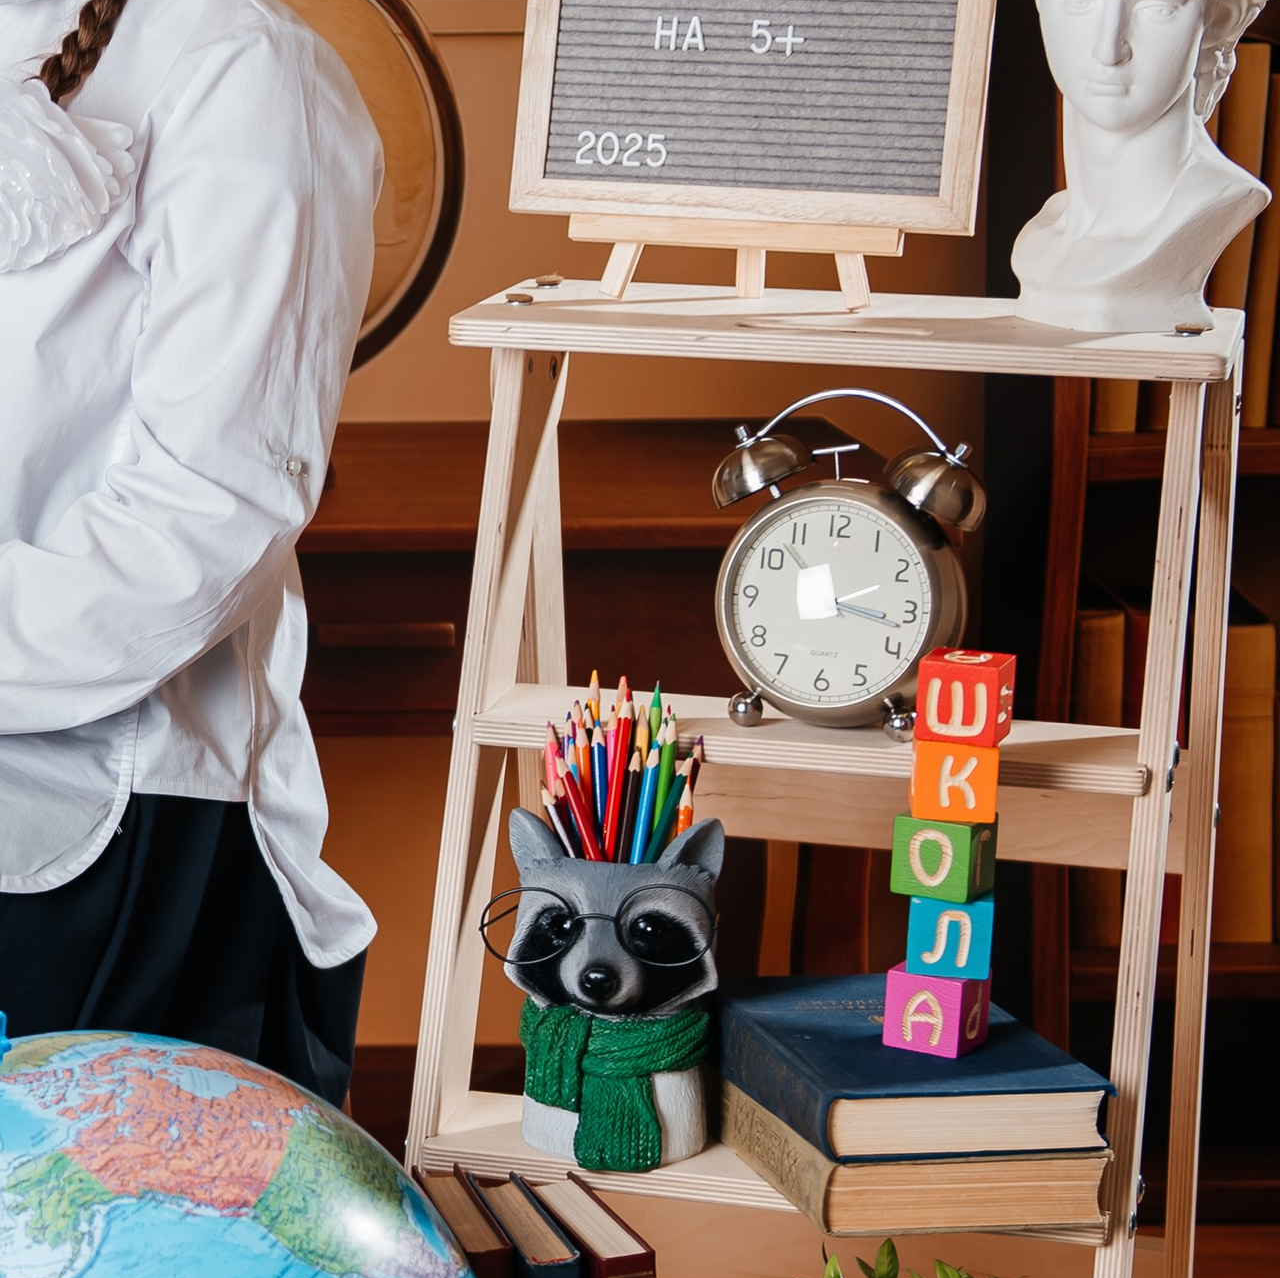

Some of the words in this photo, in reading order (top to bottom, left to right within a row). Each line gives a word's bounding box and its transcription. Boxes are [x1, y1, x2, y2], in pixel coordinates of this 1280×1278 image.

[654, 16, 705, 52] НА
[750, 19, 806, 57] 5+
[574, 130, 668, 168] 2025
[791, 522, 807, 545] 11
[829, 514, 851, 539] 12
[874, 529, 881, 553] 1
[760, 546, 784, 571] 10
[894, 558, 910, 583] 2
[742, 584, 759, 608] 9
[902, 599, 918, 624] 3
[750, 624, 767, 647] 8
[810, 649, 839, 659] QUARTZ
[884, 636, 902, 660] 4
[773, 653, 789, 675] 7
[852, 663, 868, 687] 5
[813, 668, 830, 692] 6
